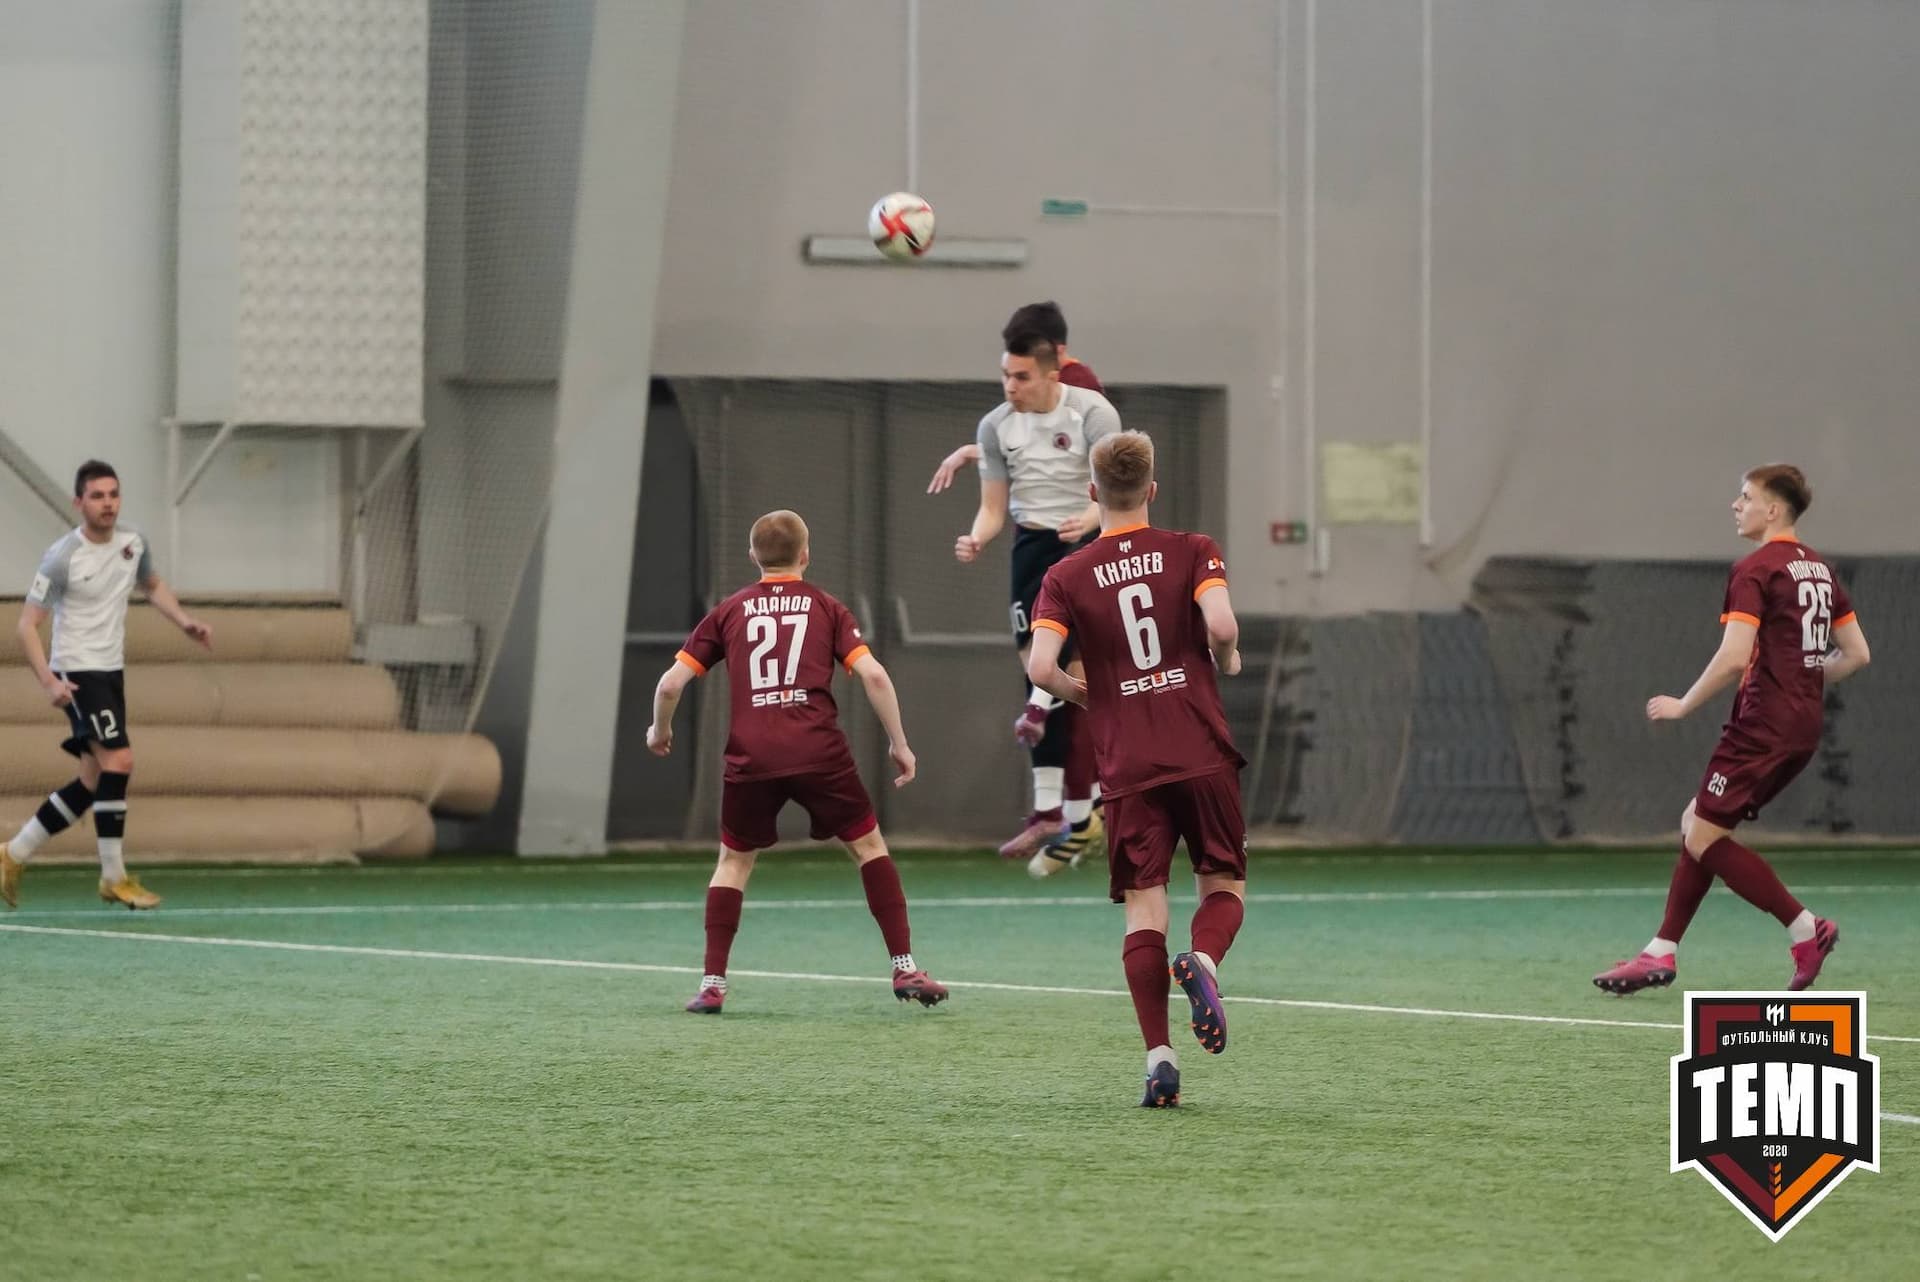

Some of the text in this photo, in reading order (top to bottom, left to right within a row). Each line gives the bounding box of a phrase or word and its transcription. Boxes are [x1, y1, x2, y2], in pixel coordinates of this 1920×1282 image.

[1093, 552, 1163, 588] КНЯЗЕВ
[742, 596, 812, 616] ЖДАНОВ
[1798, 581, 1833, 652] 25
[1117, 583, 1162, 671] 6
[747, 613, 809, 690] 27
[1120, 668, 1186, 696] SEUS
[751, 689, 808, 707] SEUS
[89, 709, 119, 740] 12
[1707, 771, 1728, 797] 25
